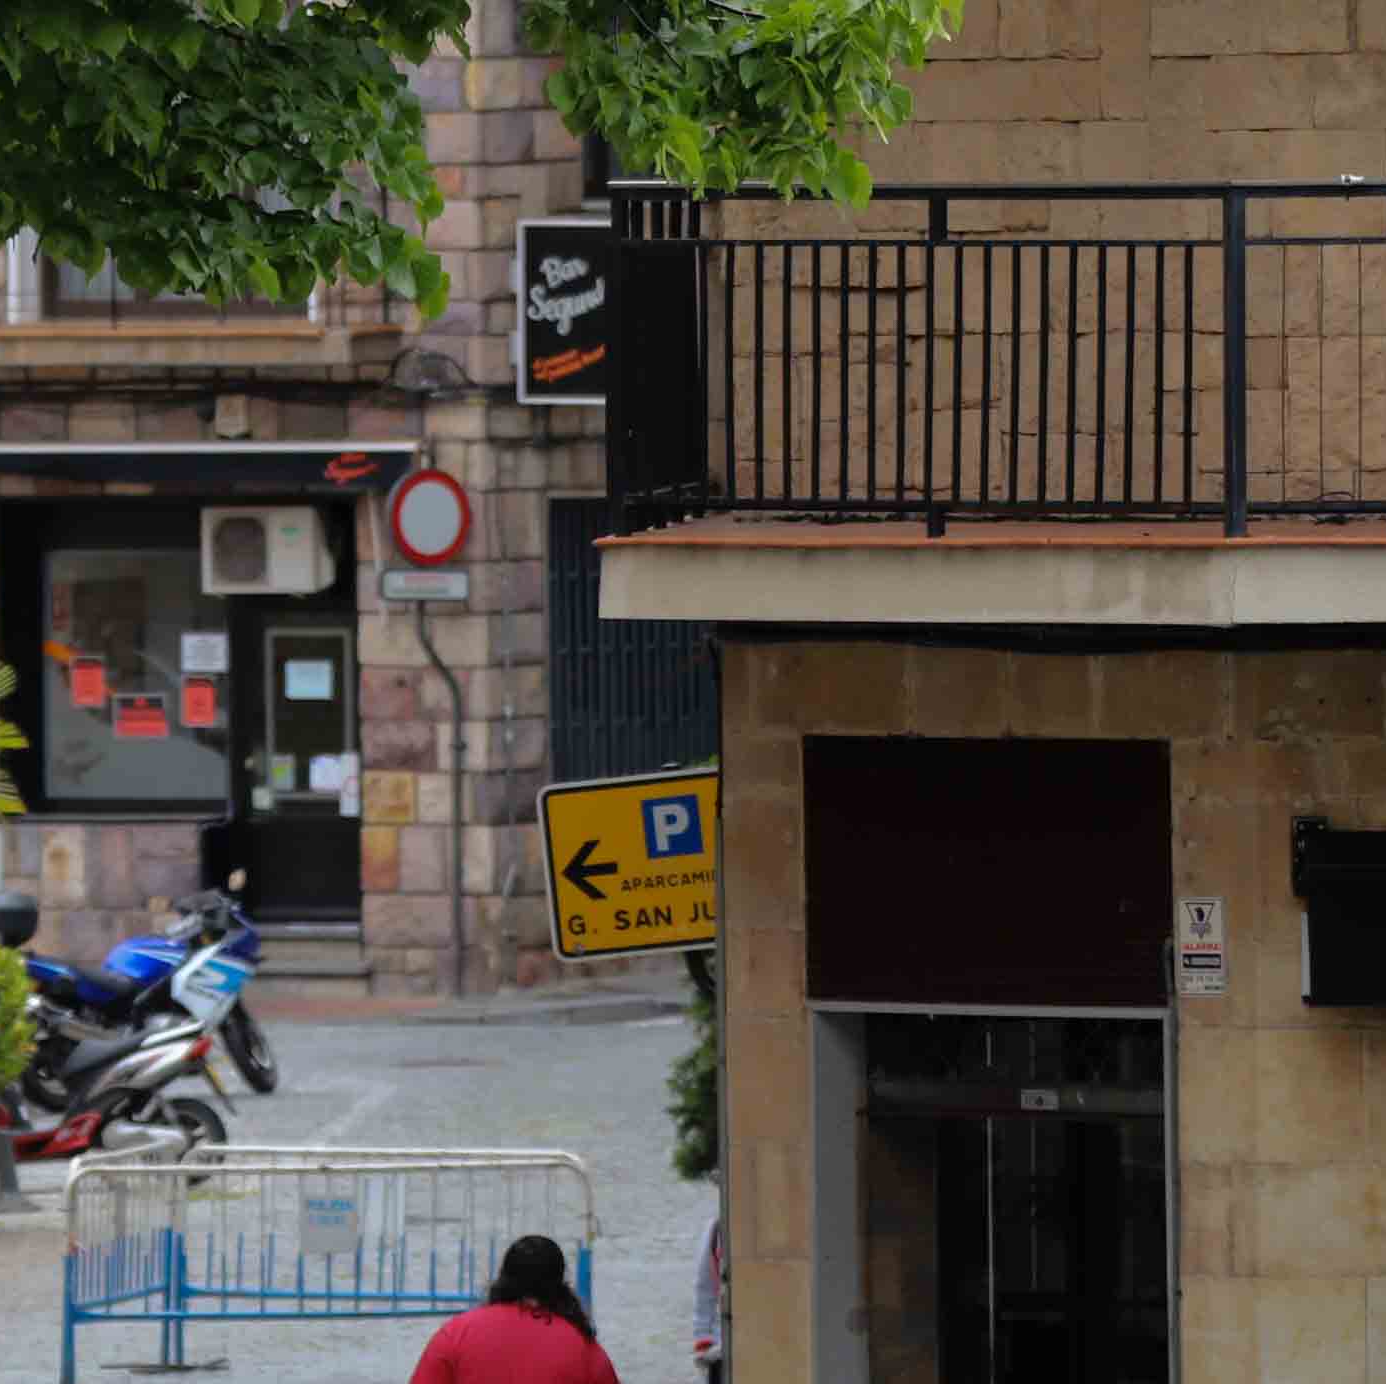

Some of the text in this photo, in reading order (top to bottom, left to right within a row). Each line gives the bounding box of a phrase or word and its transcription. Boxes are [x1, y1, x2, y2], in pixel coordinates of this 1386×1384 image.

[652, 803, 690, 851] P
[567, 915, 599, 937] G.
[614, 903, 673, 931] SAN
